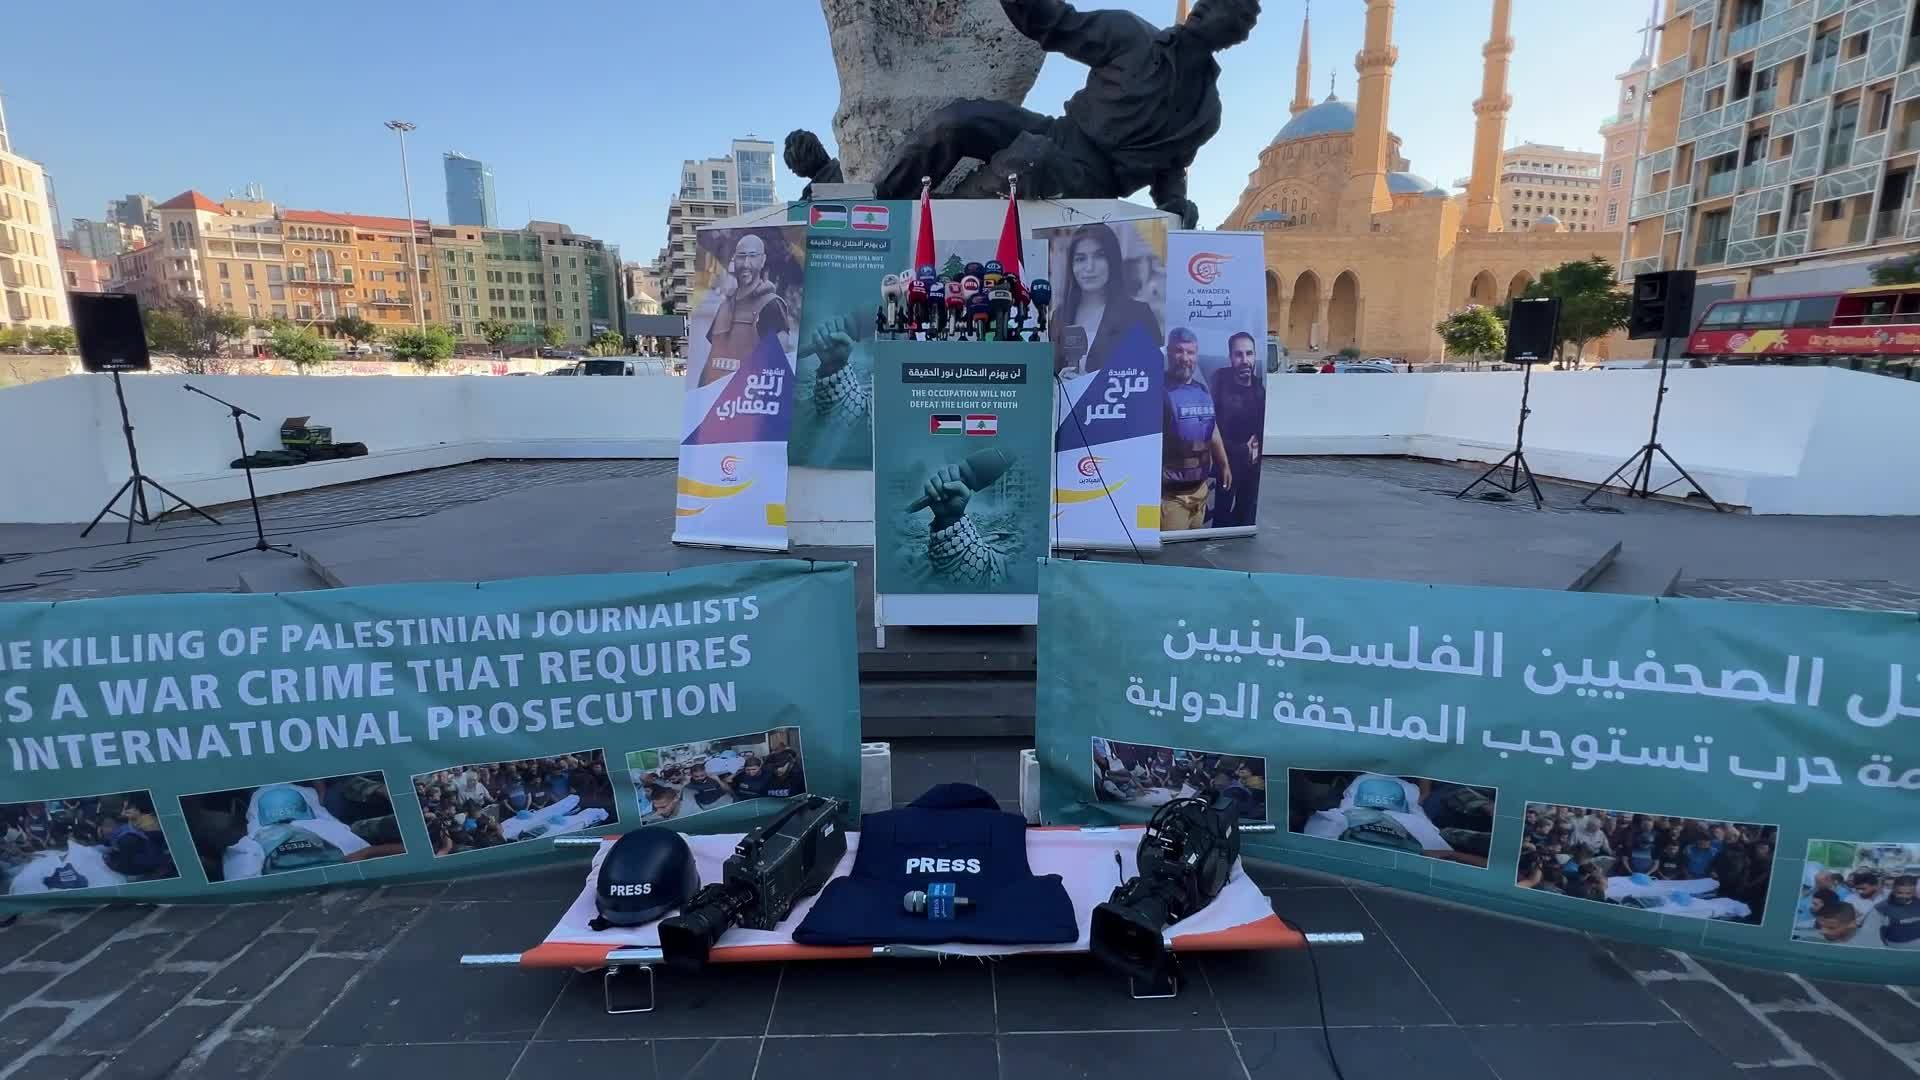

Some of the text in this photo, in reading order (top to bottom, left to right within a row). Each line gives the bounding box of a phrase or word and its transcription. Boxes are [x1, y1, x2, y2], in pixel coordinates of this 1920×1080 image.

[744, 374, 783, 400] ربيع
[908, 367, 1021, 380] لن يهزم الاحتلال نور الحقيقة
[1104, 370, 1149, 403] فرح
[910, 400, 1018, 409] DEFEAT THE LIGHT OF TRUTH
[912, 389, 1017, 398] THE OCCUPATION WILL NOT
[1181, 406, 1215, 417] PRESS
[1084, 403, 1126, 426] عمر
[43, 630, 206, 669] KILLING
[217, 626, 269, 657] OF
[281, 612, 521, 653] PALESTINIAN
[531, 595, 760, 639] JOURNALISTS
[1163, 616, 1504, 679] الفلسطينيين
[50, 683, 89, 721] A
[98, 674, 222, 716] WAR
[238, 661, 395, 707] CRIME
[407, 653, 525, 694] THAT
[538, 633, 753, 686] REQUIRES
[1523, 647, 1825, 708] الصحفيين
[1125, 675, 1259, 723] الدولية
[7, 681, 737, 772] INTERNATIONAL PROSECUTION
[1272, 690, 1466, 745] الملاحقة
[1481, 726, 1714, 773] تستوجب
[1728, 753, 1843, 793] حرب
[905, 856, 981, 875] PRESS
[610, 883, 652, 897] PRESS
